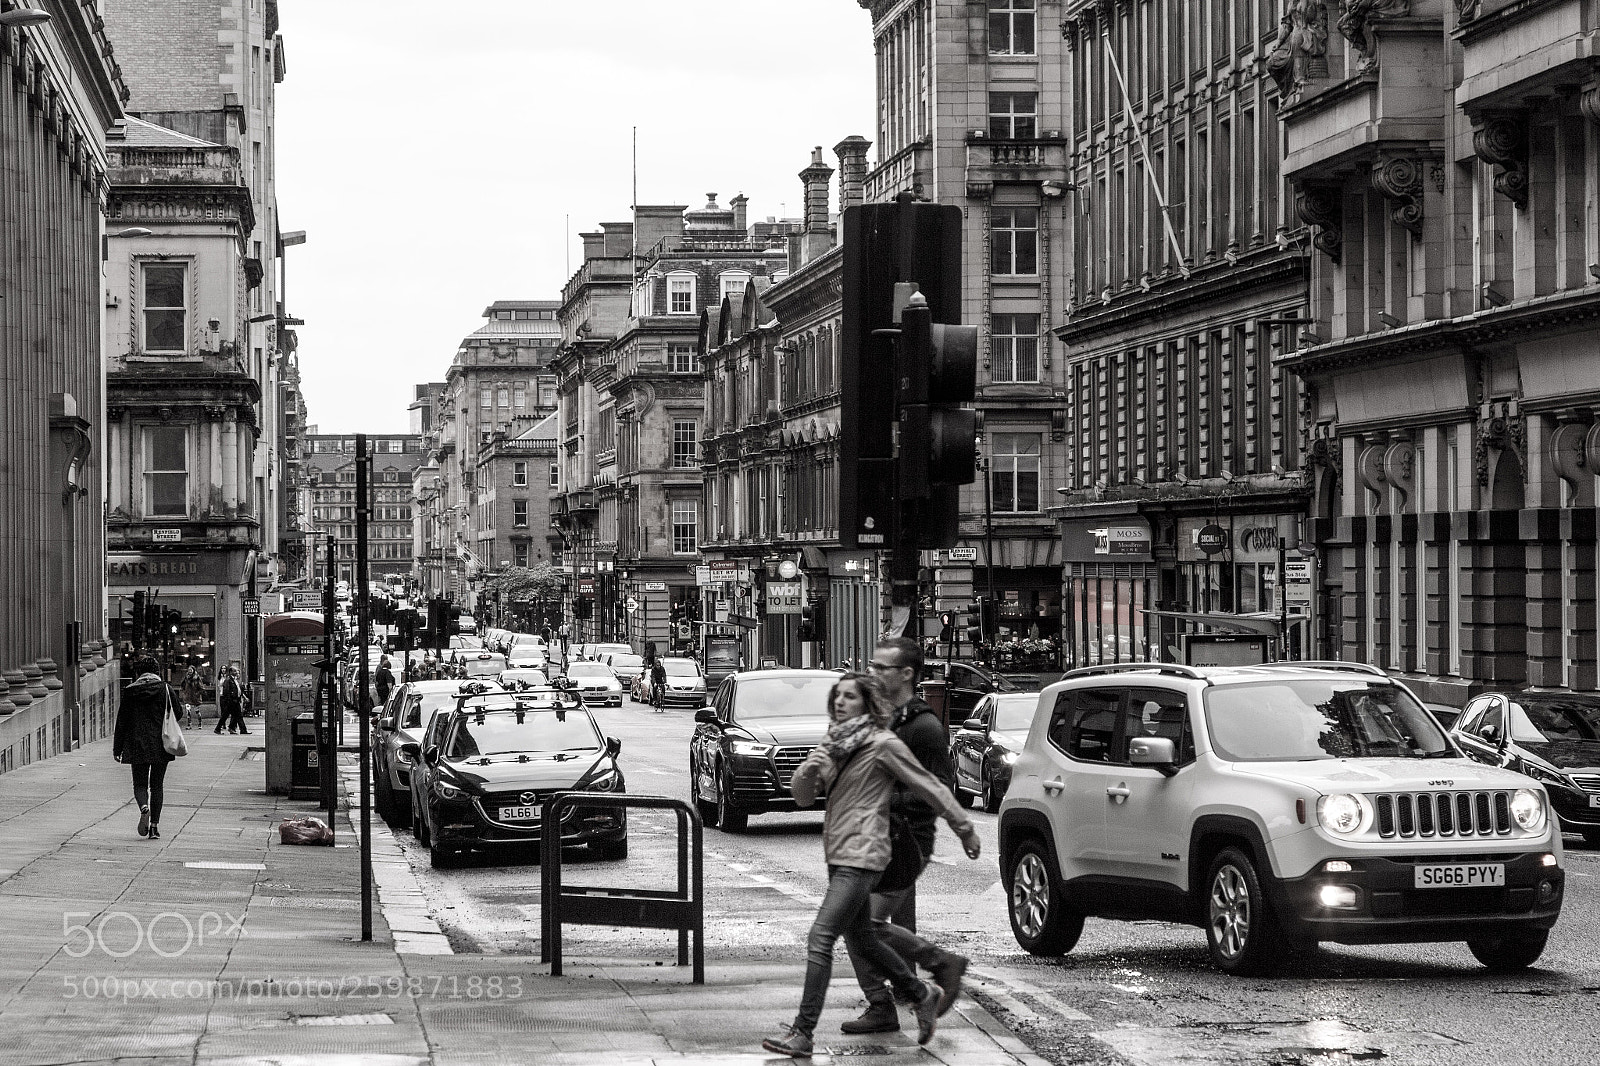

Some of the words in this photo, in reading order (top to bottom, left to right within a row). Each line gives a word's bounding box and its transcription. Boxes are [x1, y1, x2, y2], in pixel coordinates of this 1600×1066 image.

[1116, 530, 1143, 538] MOSS
[107, 562, 147, 575] EATS
[149, 562, 197, 574] BREAD
[770, 583, 800, 596] wbf
[768, 597, 781, 606] TO
[785, 597, 802, 606] LET
[503, 807, 531, 818] SL66
[1423, 867, 1464, 884] SG66
[1468, 866, 1498, 883] PYY
